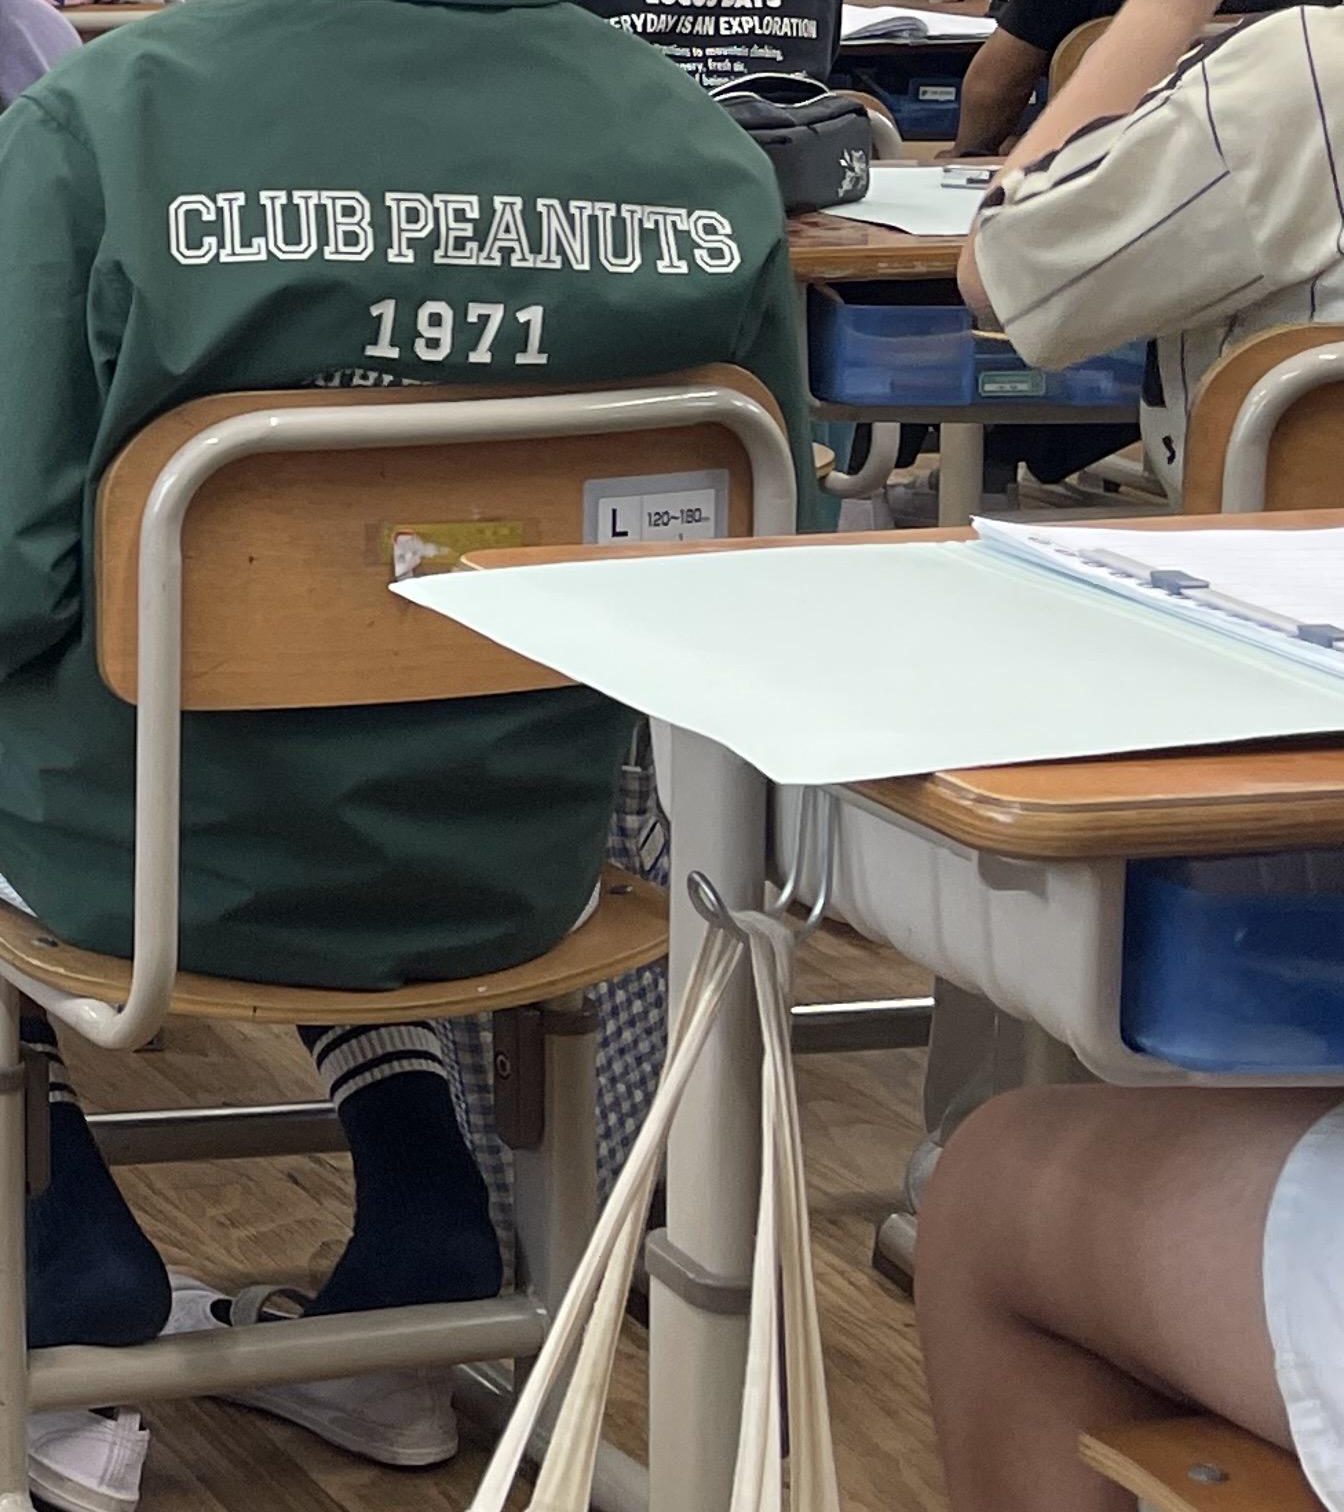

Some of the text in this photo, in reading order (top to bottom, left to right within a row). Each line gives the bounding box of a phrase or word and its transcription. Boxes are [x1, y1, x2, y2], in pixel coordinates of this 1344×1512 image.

[677, 15, 692, 34] IS
[694, 16, 716, 35] AN
[719, 16, 817, 39] EXPLORATION
[169, 190, 742, 274] CLUB PEANUTS
[364, 298, 549, 365] 1971
[611, 508, 629, 538] L
